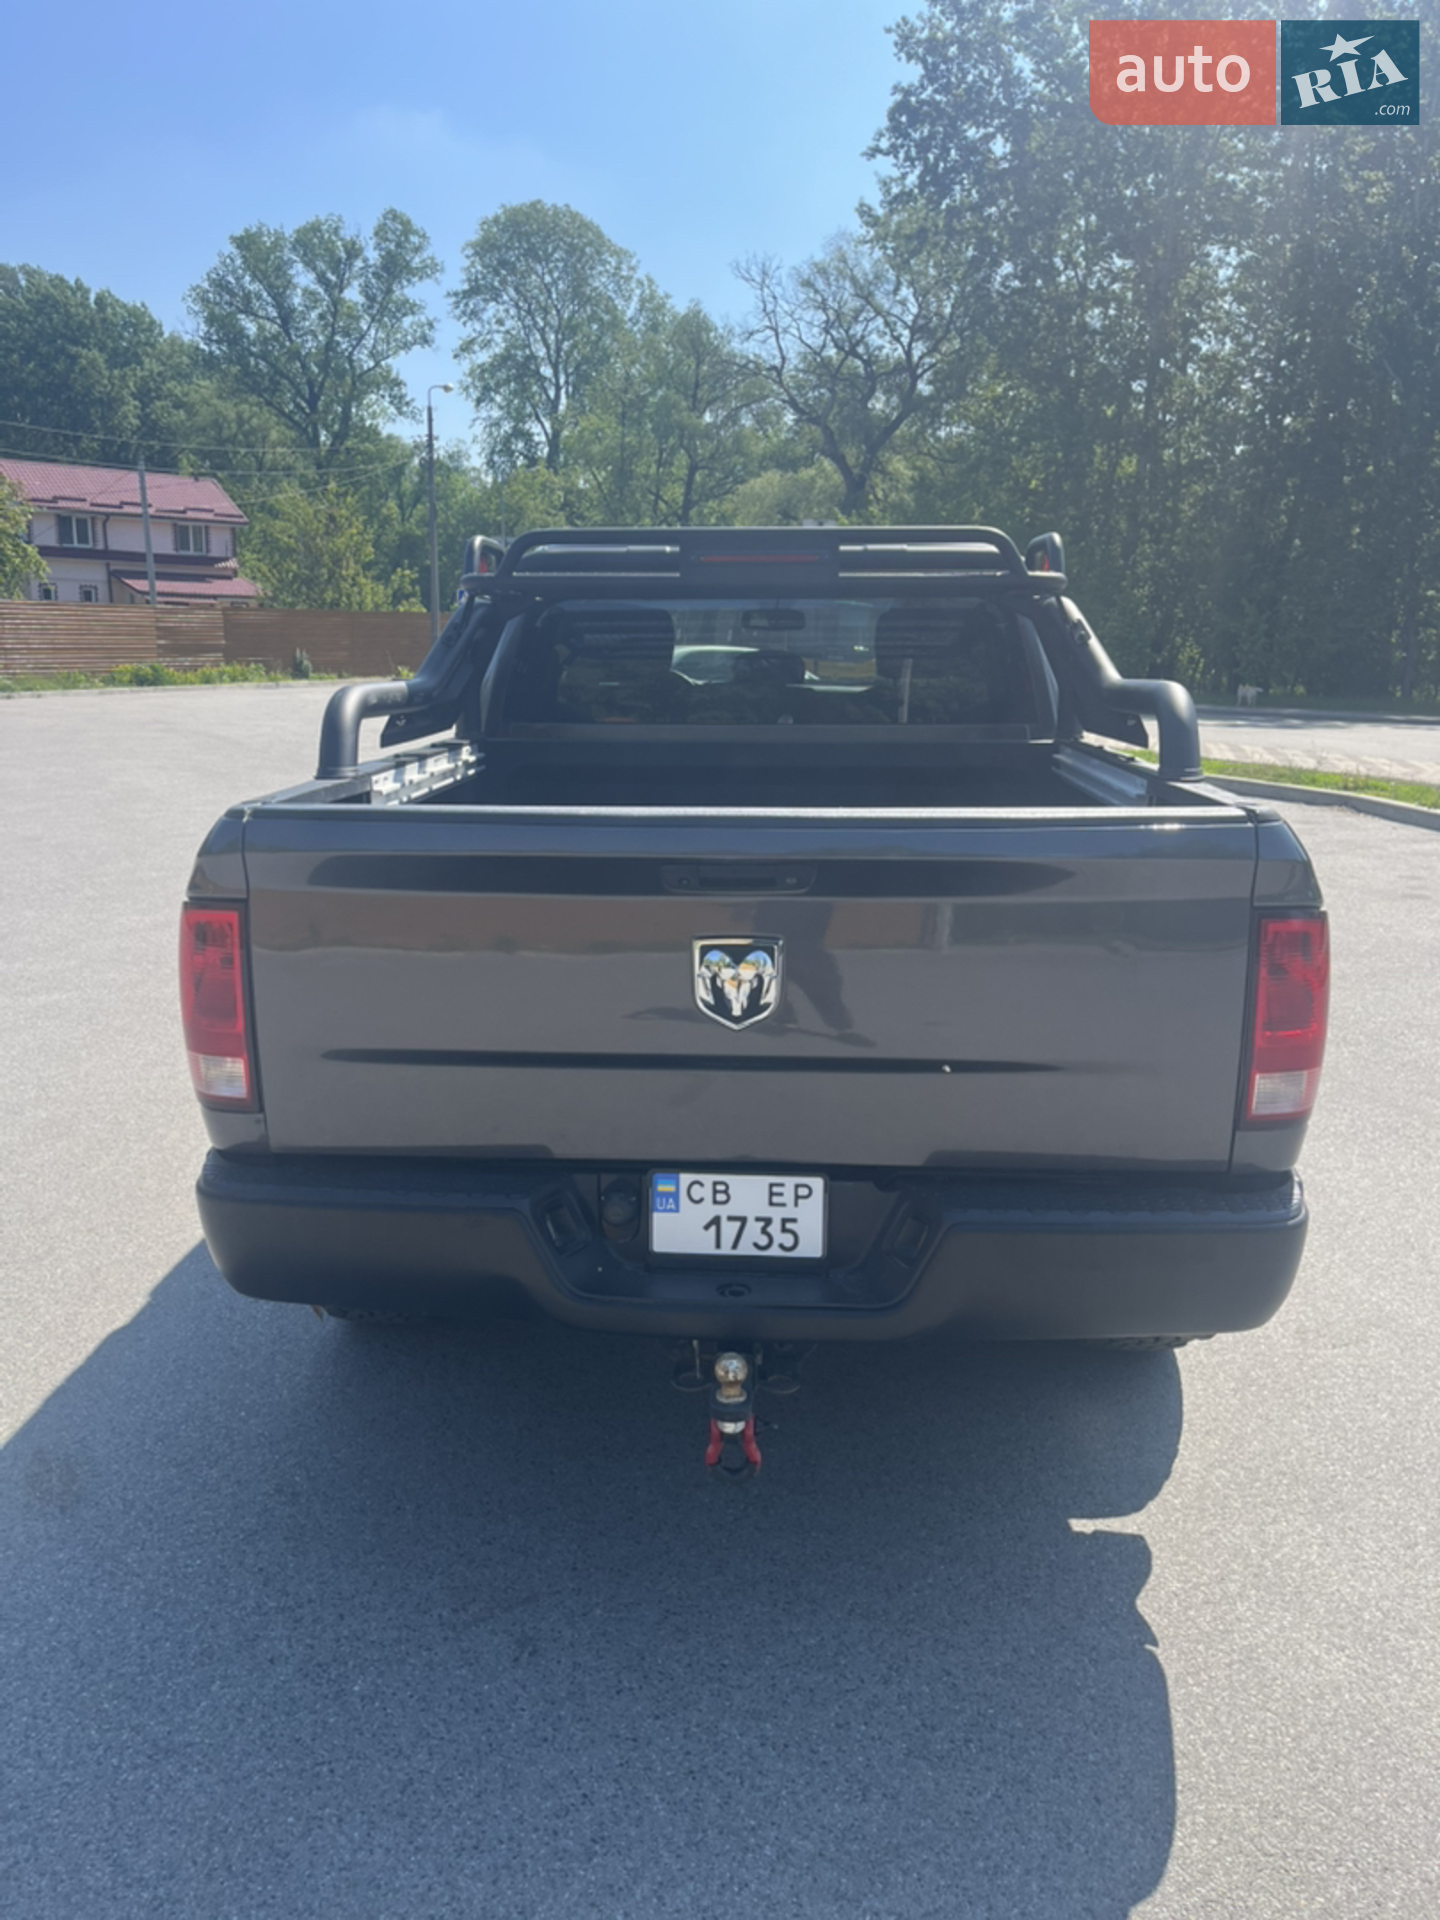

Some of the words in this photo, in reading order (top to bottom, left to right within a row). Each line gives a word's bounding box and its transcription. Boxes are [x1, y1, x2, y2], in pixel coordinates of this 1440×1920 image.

[656, 1198, 677, 1211] UA
[686, 1180, 731, 1206] CB
[768, 1182, 813, 1208] EP
[702, 1215, 800, 1252] 1735
